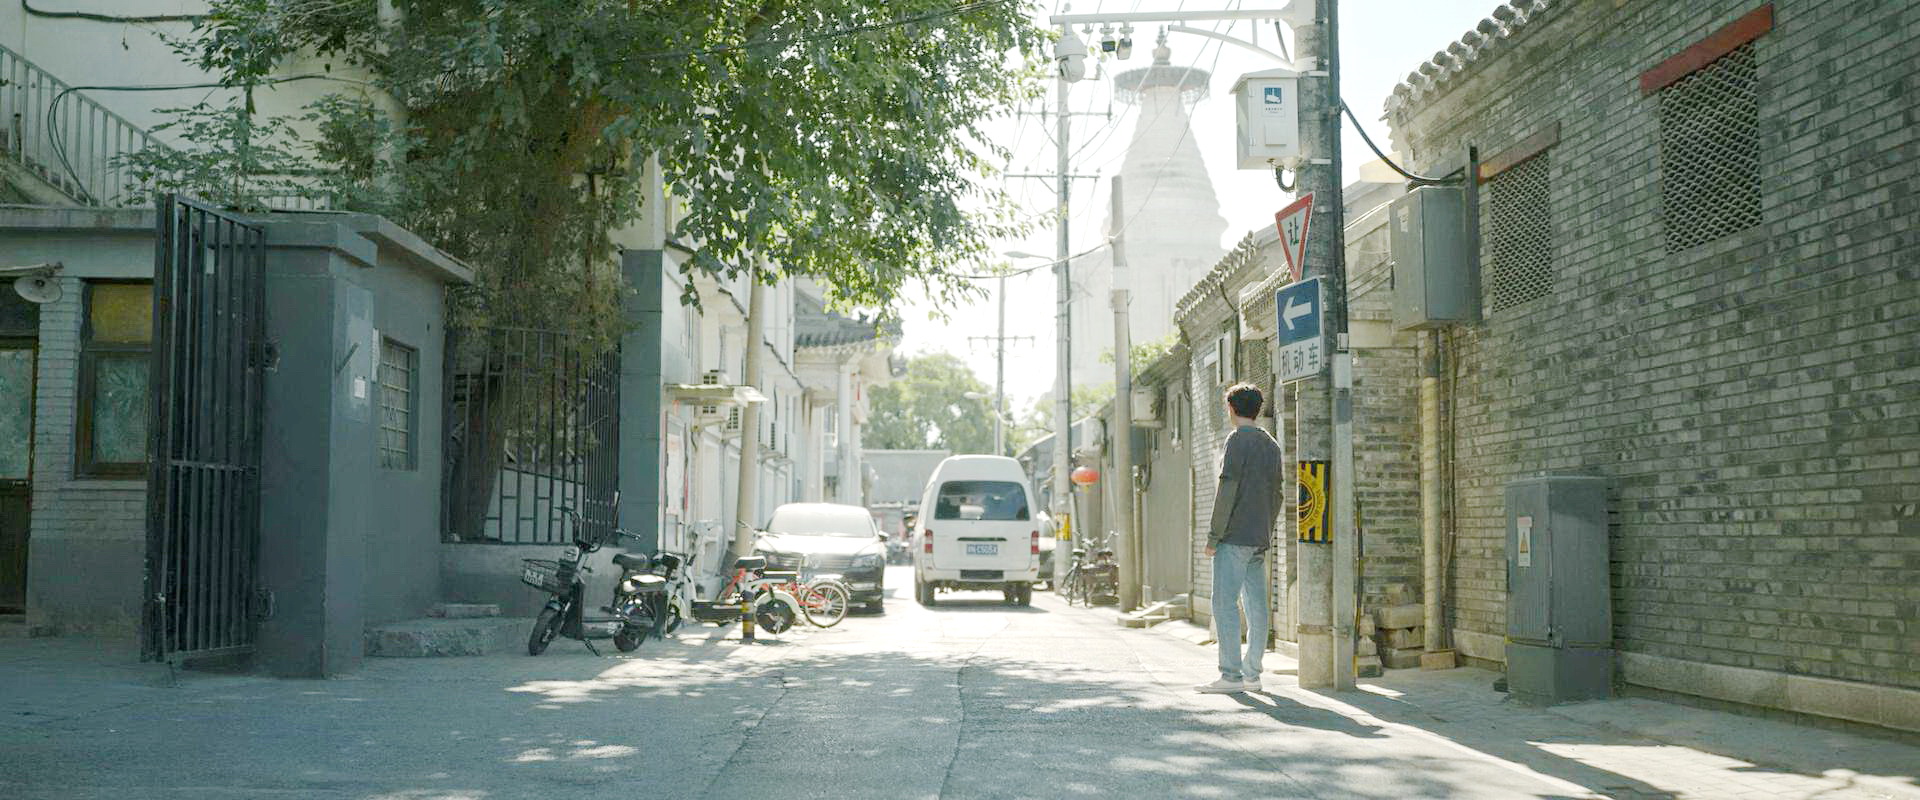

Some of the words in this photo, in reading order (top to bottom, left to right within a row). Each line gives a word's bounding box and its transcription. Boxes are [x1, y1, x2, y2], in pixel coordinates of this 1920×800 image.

[1287, 216, 1299, 246] 让
[1281, 343, 1318, 373] 机动车
